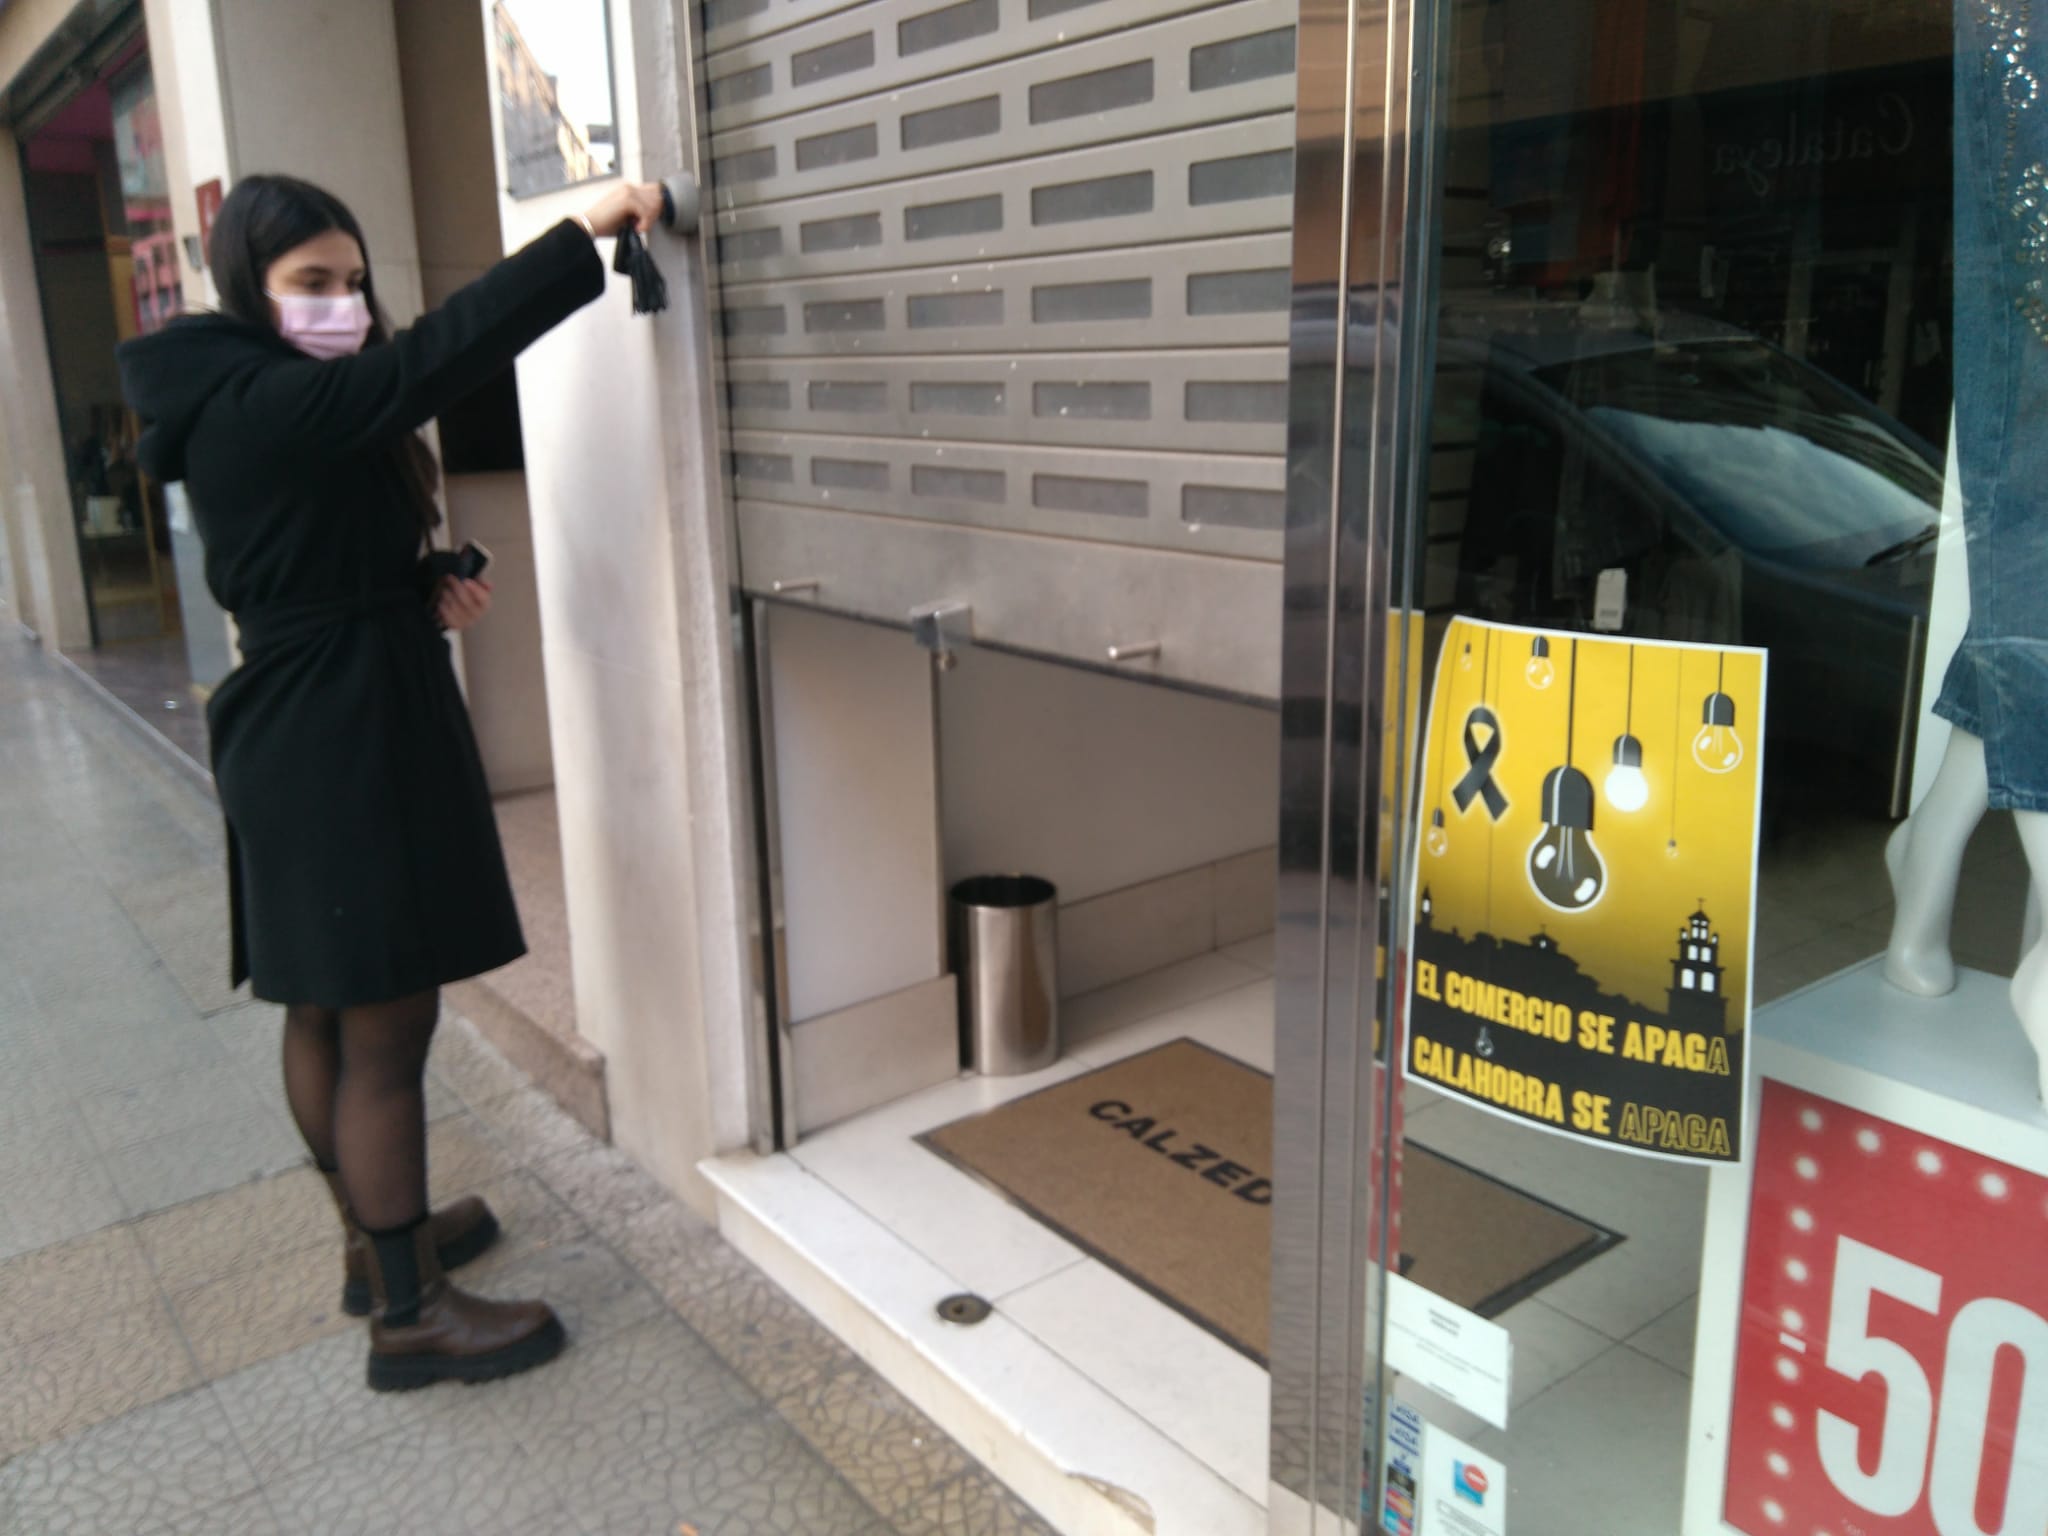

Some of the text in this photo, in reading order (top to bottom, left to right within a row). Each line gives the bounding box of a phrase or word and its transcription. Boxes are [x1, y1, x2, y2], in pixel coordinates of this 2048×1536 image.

[1416, 959, 1730, 1076] EL COMERCIO SE APAGA
[1413, 1035, 1731, 1156] CALAHORRA SE APAGA
